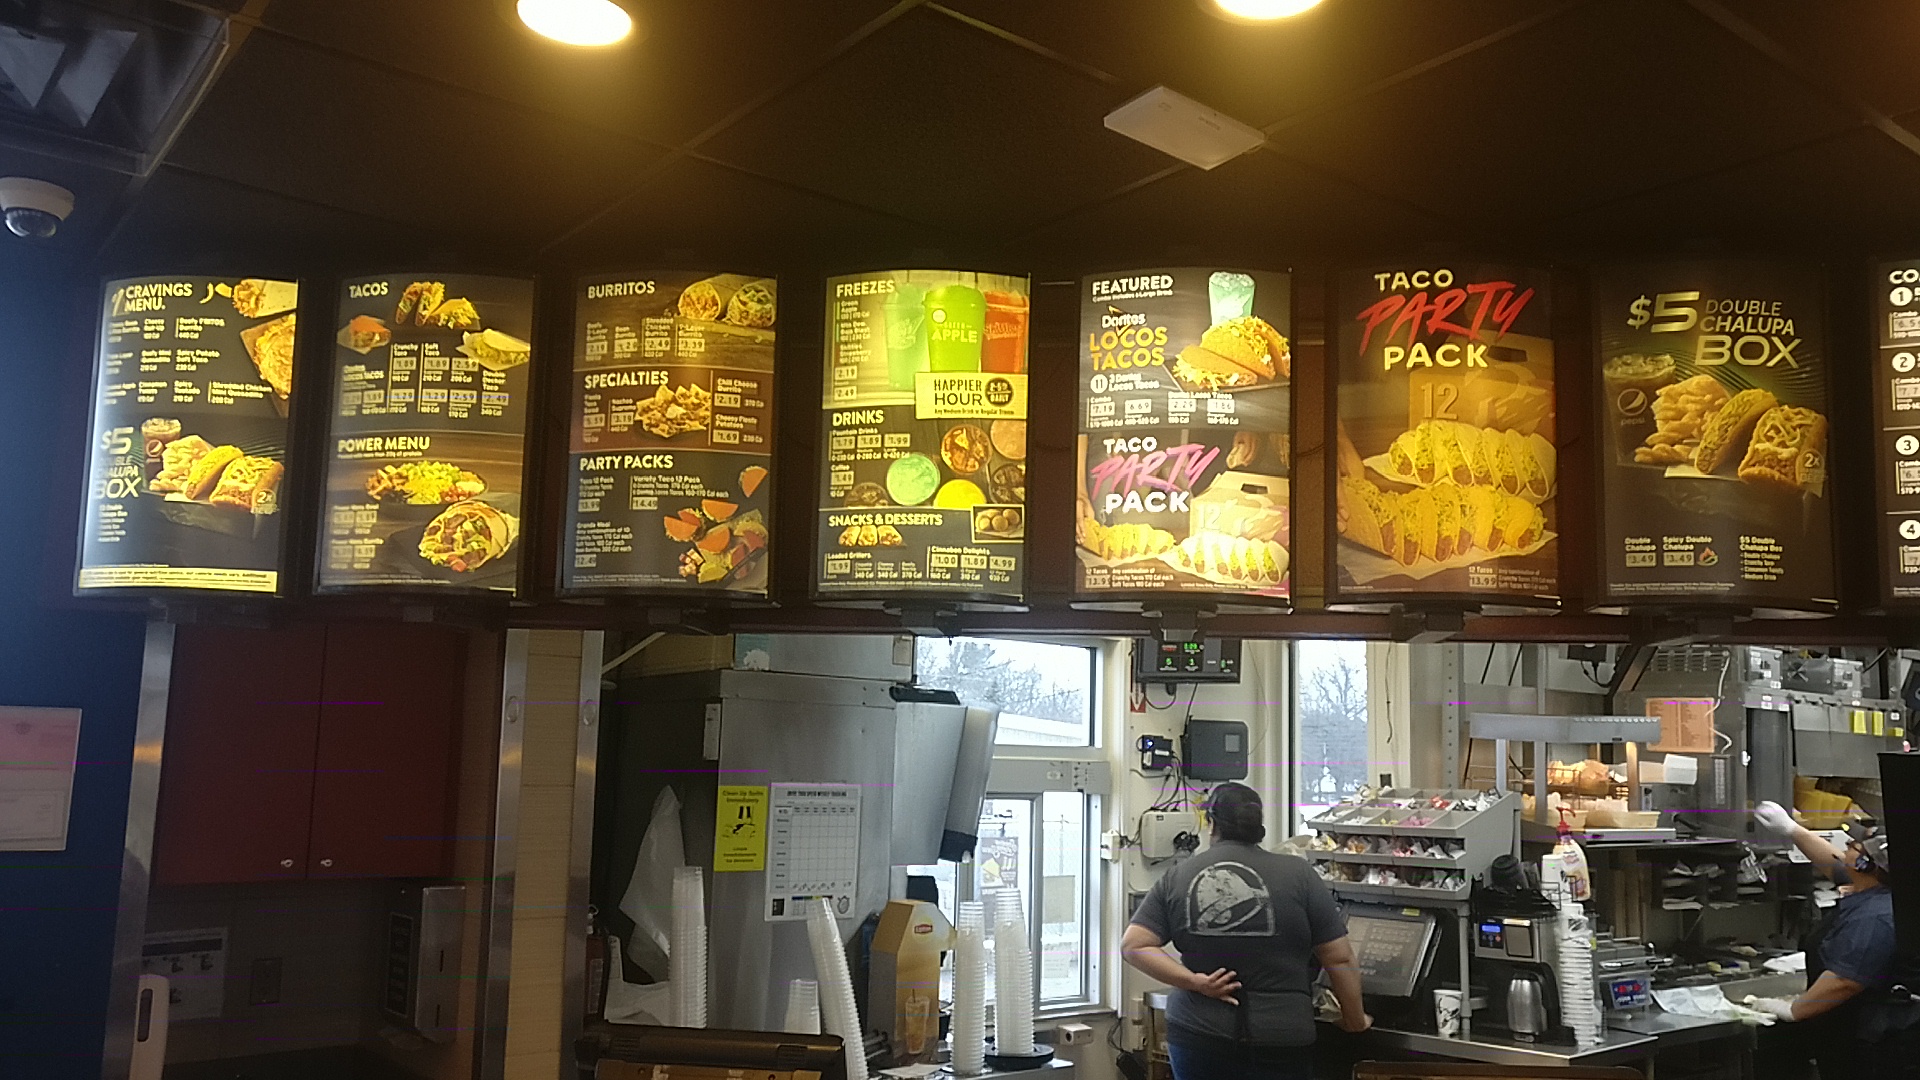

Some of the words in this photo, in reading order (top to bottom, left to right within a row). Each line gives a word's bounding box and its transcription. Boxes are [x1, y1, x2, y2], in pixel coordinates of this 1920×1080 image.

[836, 280, 895, 298] FREEZES
[1092, 275, 1174, 296] FEATURED
[1374, 268, 1454, 293] TACO
[125, 283, 193, 299] CRAVINGS
[349, 281, 389, 299] TACOS
[587, 281, 656, 299] BURRITOS
[1897, 290, 1905, 303] 1
[124, 297, 166, 312] MENU.
[1626, 290, 1700, 334] $5
[1705, 298, 1783, 317] DOUBLE
[1101, 313, 1147, 329] Doritos
[1356, 280, 1536, 357] PARTY
[1700, 315, 1796, 336] CHALUPA
[931, 329, 978, 344] APPLE
[1089, 326, 1169, 352] LOCOS
[394, 343, 419, 351] Crunchy
[1694, 334, 1803, 369] BOX
[1089, 347, 1165, 371] TACOS
[1383, 342, 1489, 371] PACK
[1899, 356, 1909, 368] 2
[584, 371, 669, 389] SPECIALTIES
[933, 379, 982, 391] HAPPIER
[1108, 383, 1134, 392] Locos
[1133, 380, 1160, 390] Tacos
[934, 393, 983, 406] HOUR
[1420, 382, 1459, 420] 12
[832, 409, 884, 426] DRINKS
[101, 426, 134, 455] $5
[337, 437, 383, 452] POWER
[384, 436, 431, 450] MENU
[1103, 436, 1158, 454] TACO
[1903, 439, 1912, 452] 3
[579, 455, 622, 471] PARTY
[623, 454, 674, 469] PACKS
[1090, 443, 1220, 500] PARTY
[633, 475, 657, 483] Variety
[683, 475, 701, 483] Pack
[1105, 490, 1190, 514] PACK
[828, 513, 875, 527] SNACKS
[874, 514, 885, 526] &
[884, 513, 943, 526] DESSERTS
[1198, 504, 1221, 530] 12
[1905, 523, 1916, 535] 4
[1662, 536, 1685, 544] Spicy
[1662, 543, 1695, 551] Chalupa
